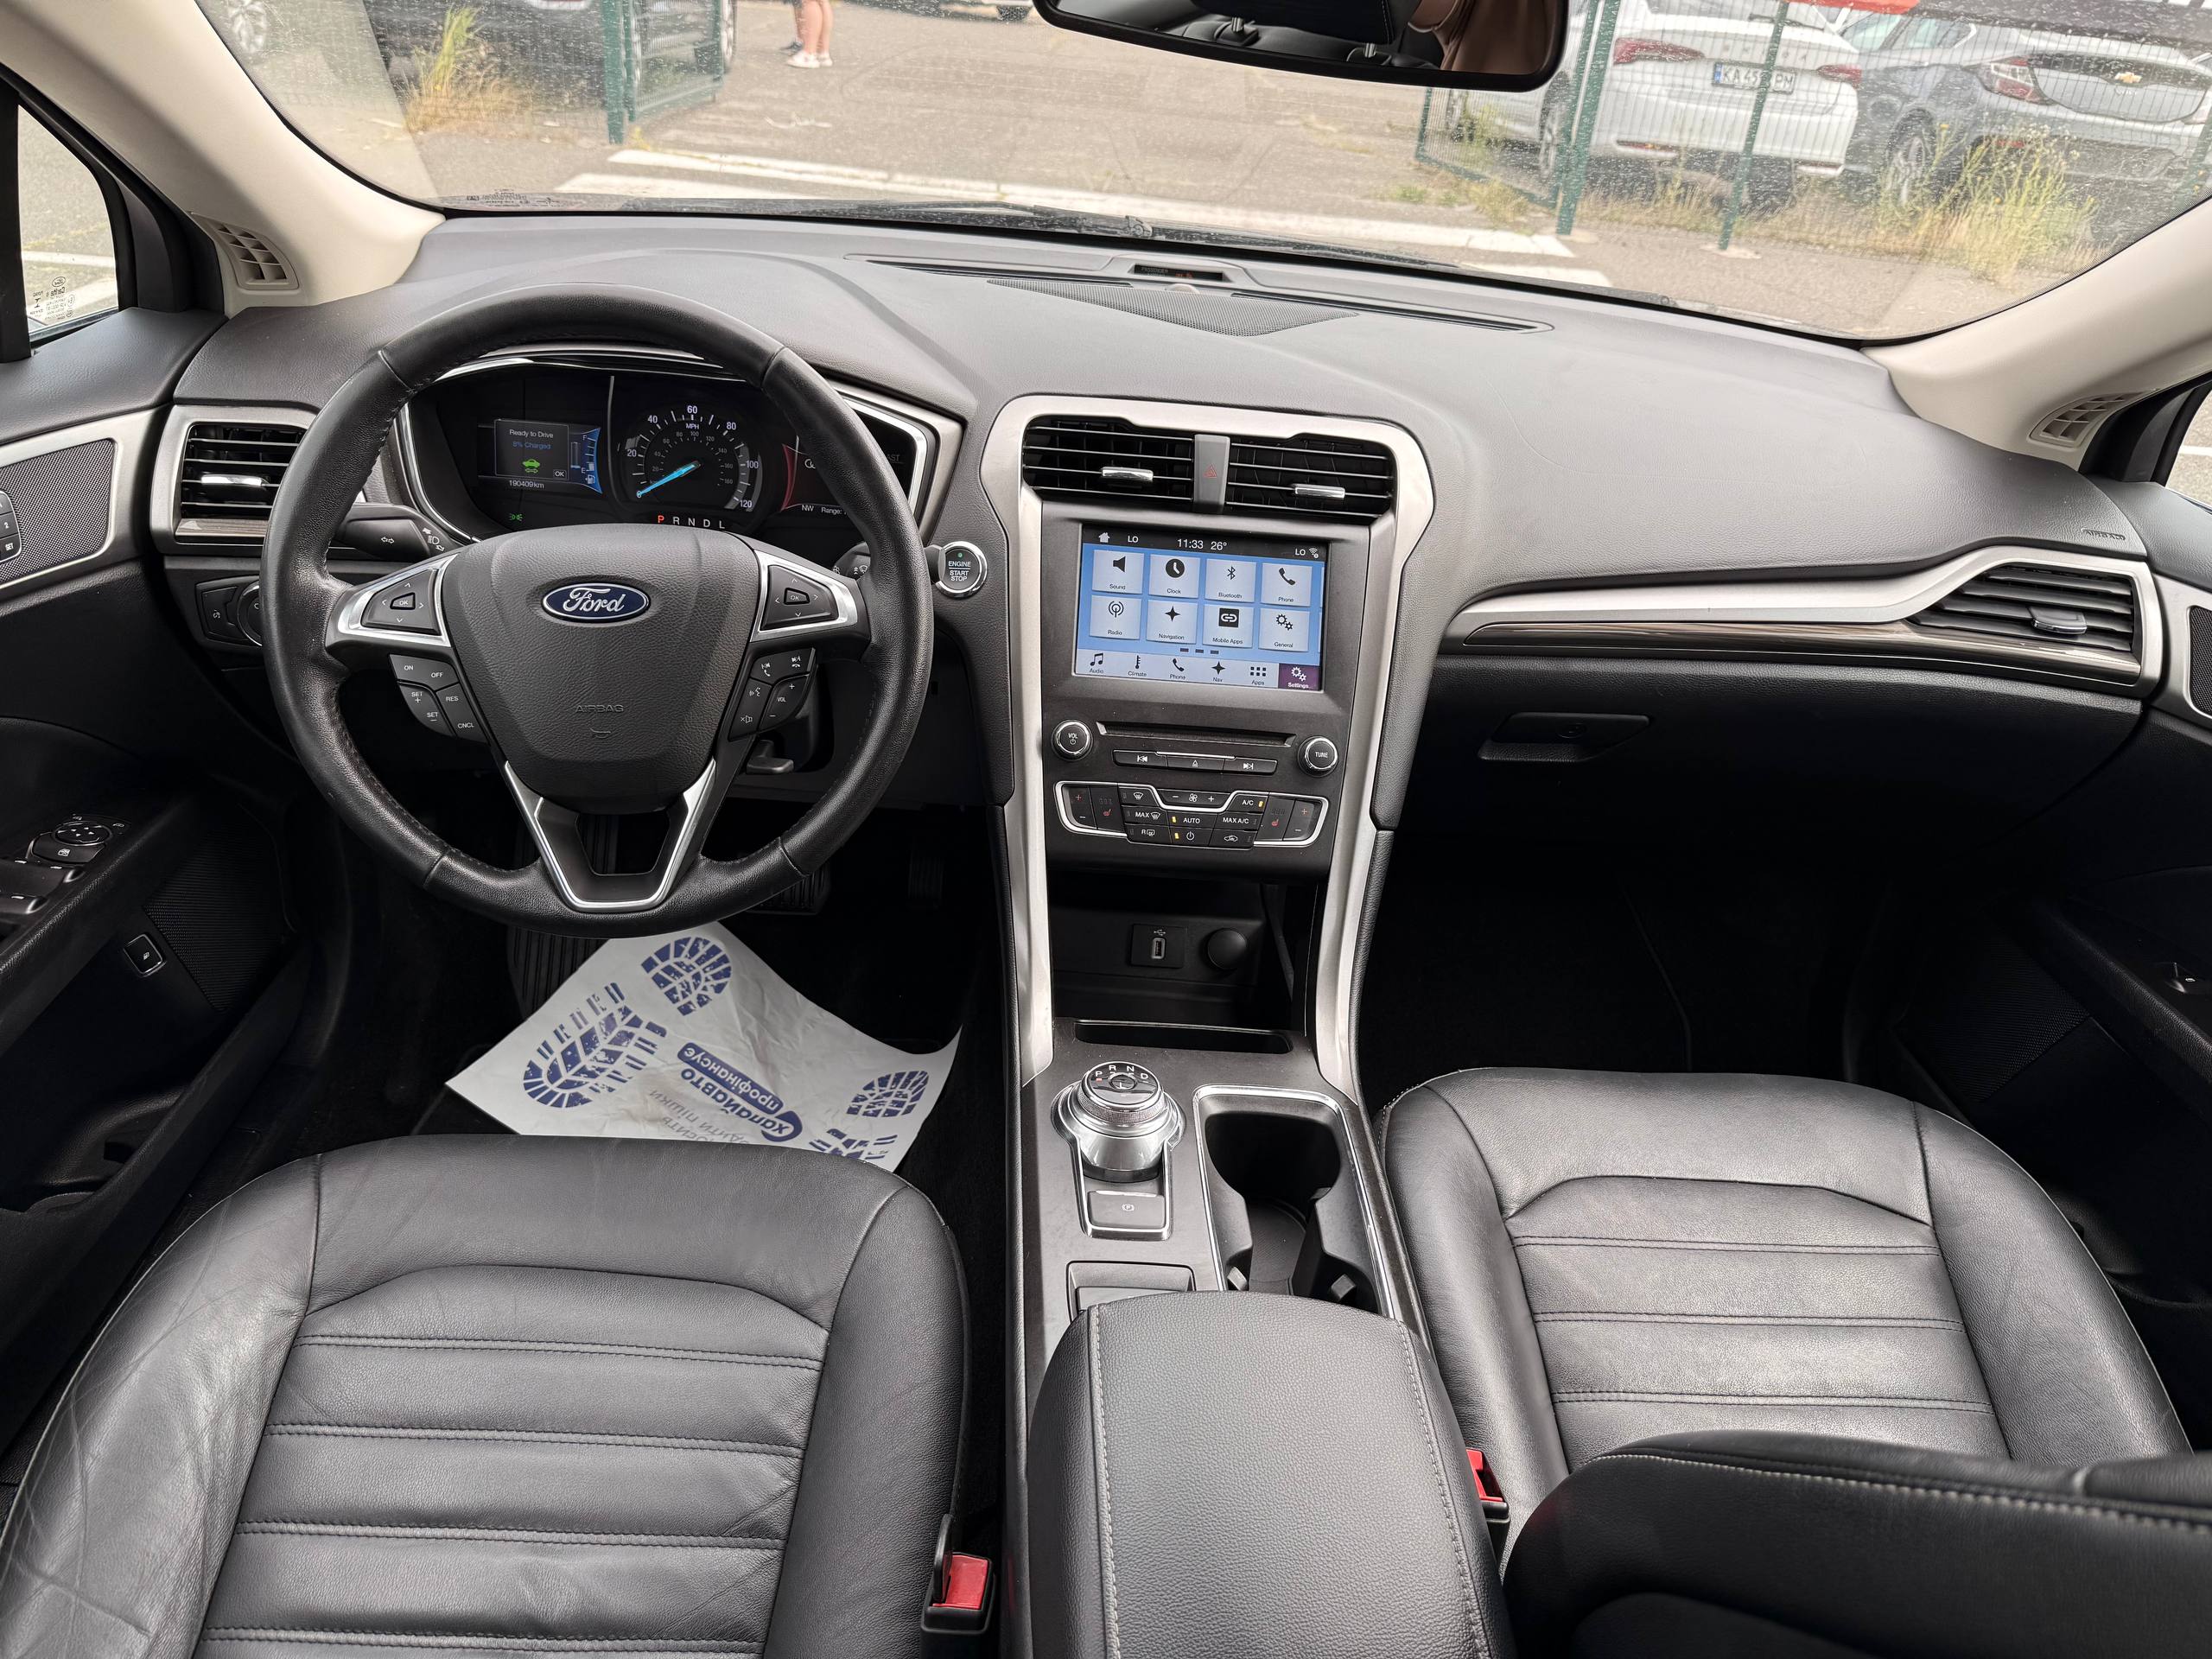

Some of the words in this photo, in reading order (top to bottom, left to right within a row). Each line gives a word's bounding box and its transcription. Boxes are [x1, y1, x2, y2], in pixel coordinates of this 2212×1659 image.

[687, 405, 698, 414] 60
[726, 422, 736, 430] 80
[509, 429, 529, 437] Ready
[746, 461, 759, 469] 100
[740, 499, 753, 508] 120
[658, 515, 664, 524] P
[688, 518, 696, 526] N
[1177, 539, 1204, 549] 11:33
[1211, 541, 1227, 550] 26°
[563, 586, 626, 613] Ford
[683, 1046, 780, 1112] профінансує
[650, 1090, 699, 1123] пішки
[681, 1068, 791, 1135] хапайавто
